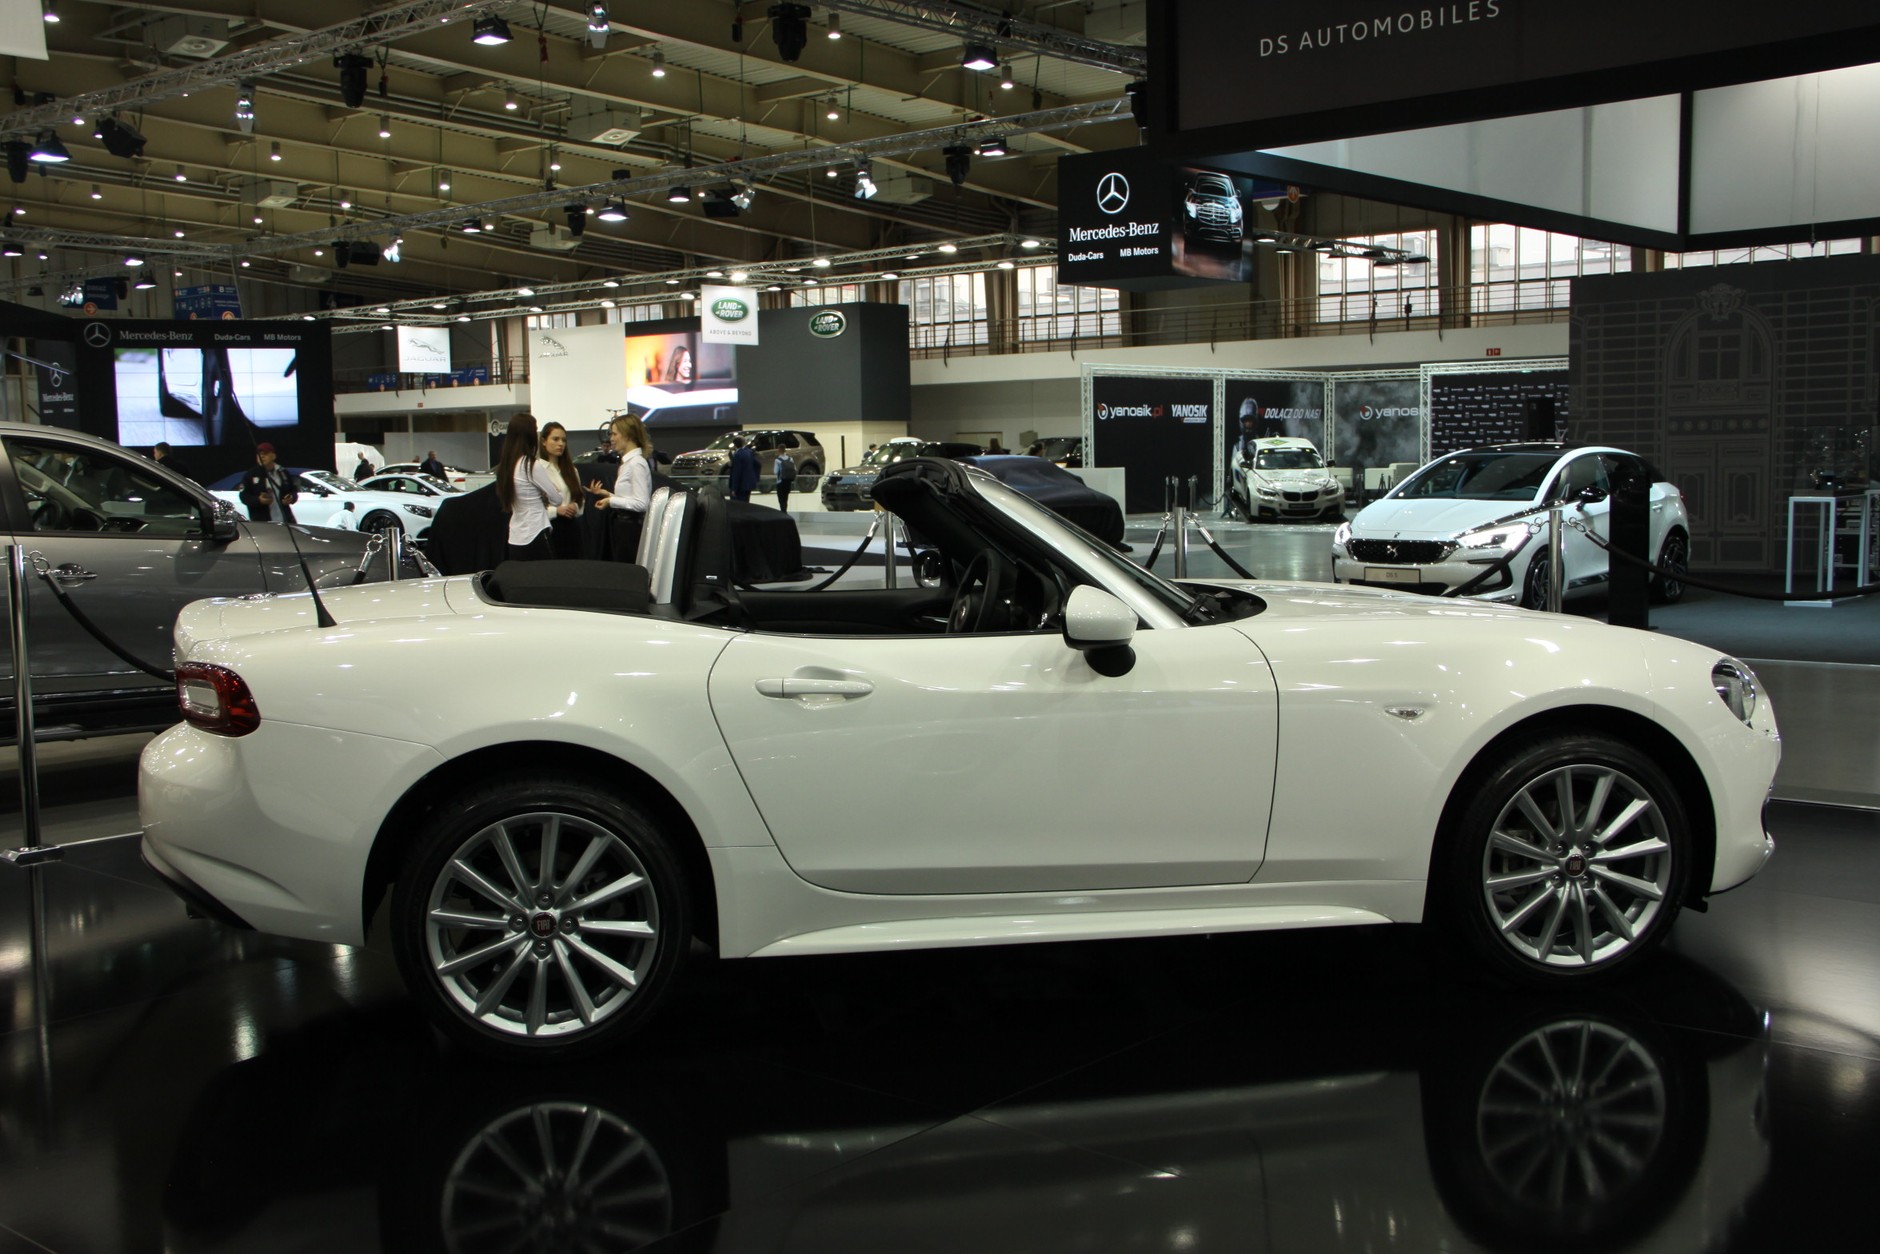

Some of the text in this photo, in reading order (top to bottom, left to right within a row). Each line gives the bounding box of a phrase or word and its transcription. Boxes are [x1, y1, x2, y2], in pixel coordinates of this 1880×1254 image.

[1260, 0, 1500, 57] DS AUTOMOBILES
[1069, 222, 1159, 243] Mercedes-Benz
[1068, 246, 1159, 262] Duda-Cars MB Motors
[718, 301, 737, 310] LAND
[719, 310, 744, 318] ROVER
[816, 315, 834, 324] LAND
[817, 324, 839, 332] ROVER
[119, 331, 193, 341] Mercedes-Benz
[214, 333, 251, 341] Duda-Cars
[1109, 404, 1208, 419] yanosik.pl YANOSIK
[1375, 406, 1429, 419] yanos
